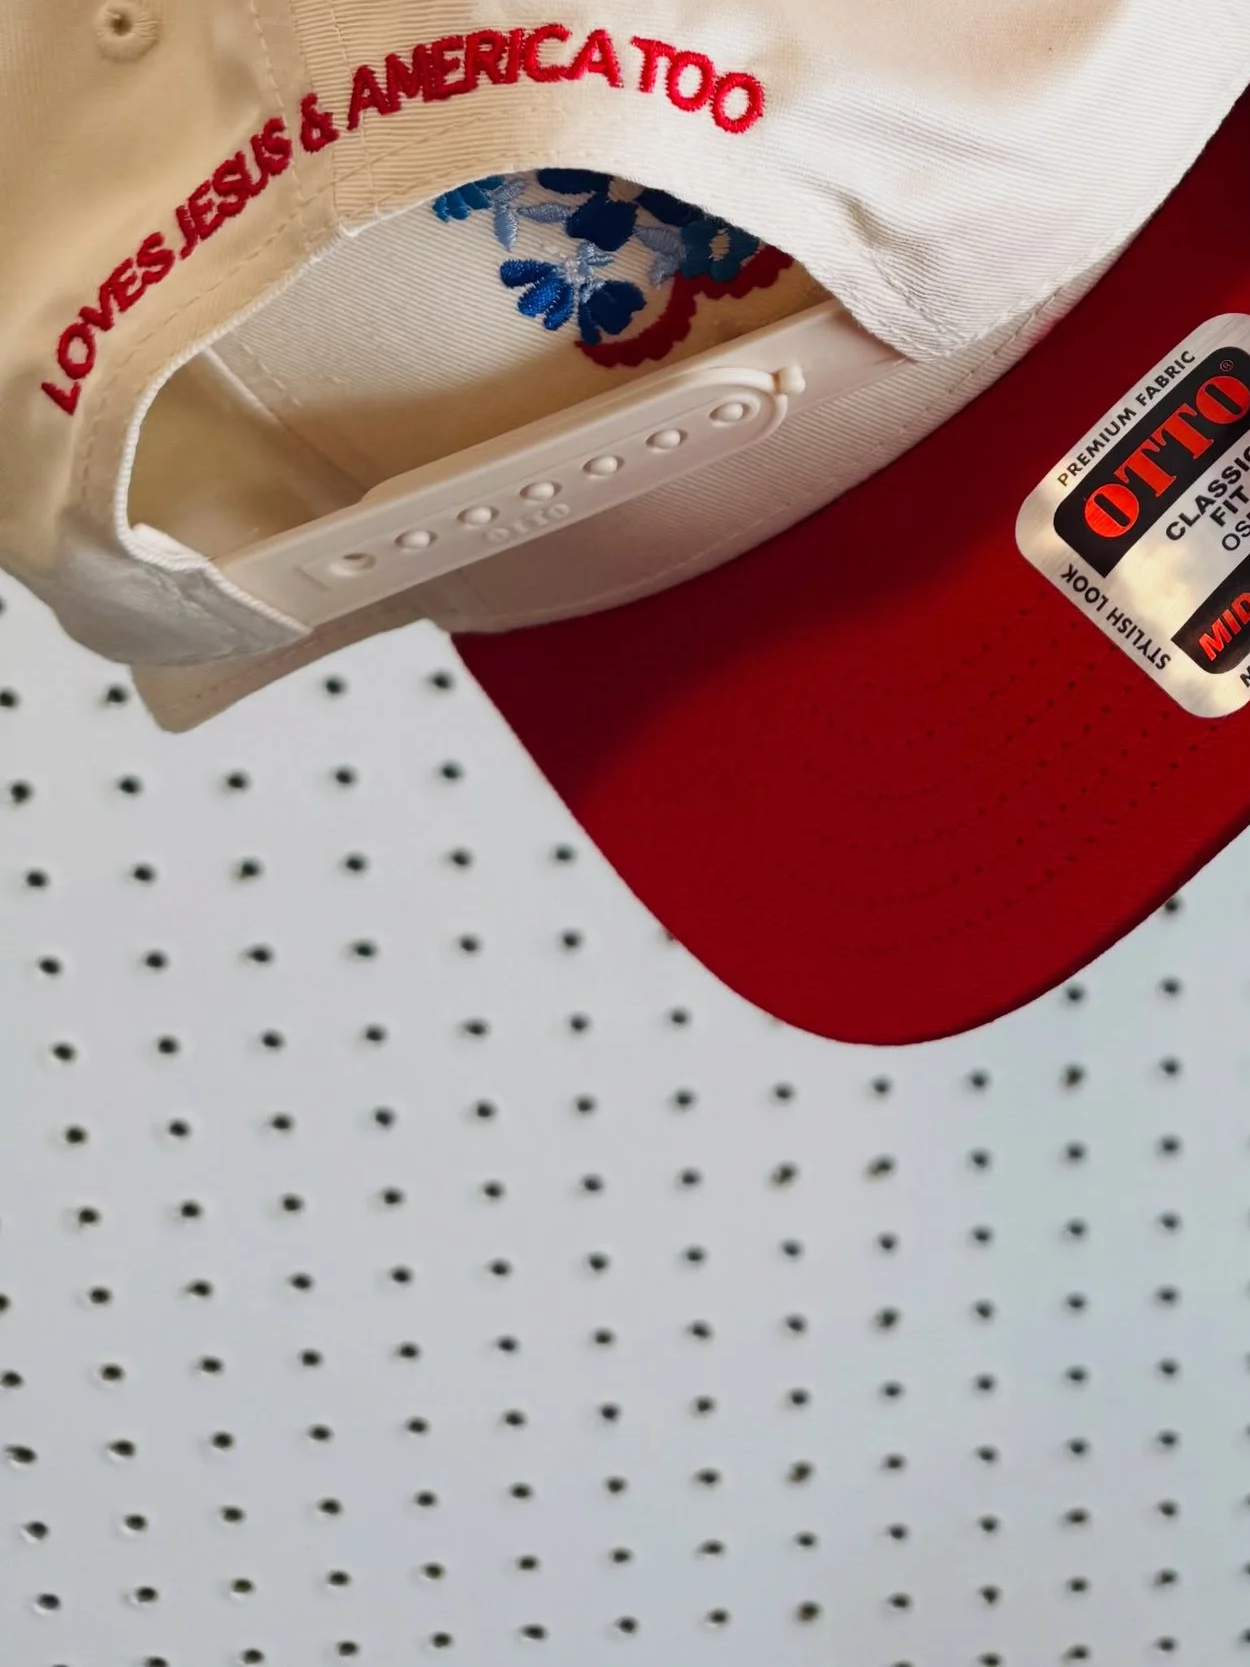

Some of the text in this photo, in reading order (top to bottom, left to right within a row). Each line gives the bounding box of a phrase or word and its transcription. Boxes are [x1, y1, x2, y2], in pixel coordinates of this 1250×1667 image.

[42, 23, 765, 415] LOVES JESUS & AMERICA TOO
[1057, 351, 1197, 488] PREMIUM FABRIC
[1210, 485, 1250, 528] FIT
[1061, 563, 1172, 671] STYLISH LOOK
